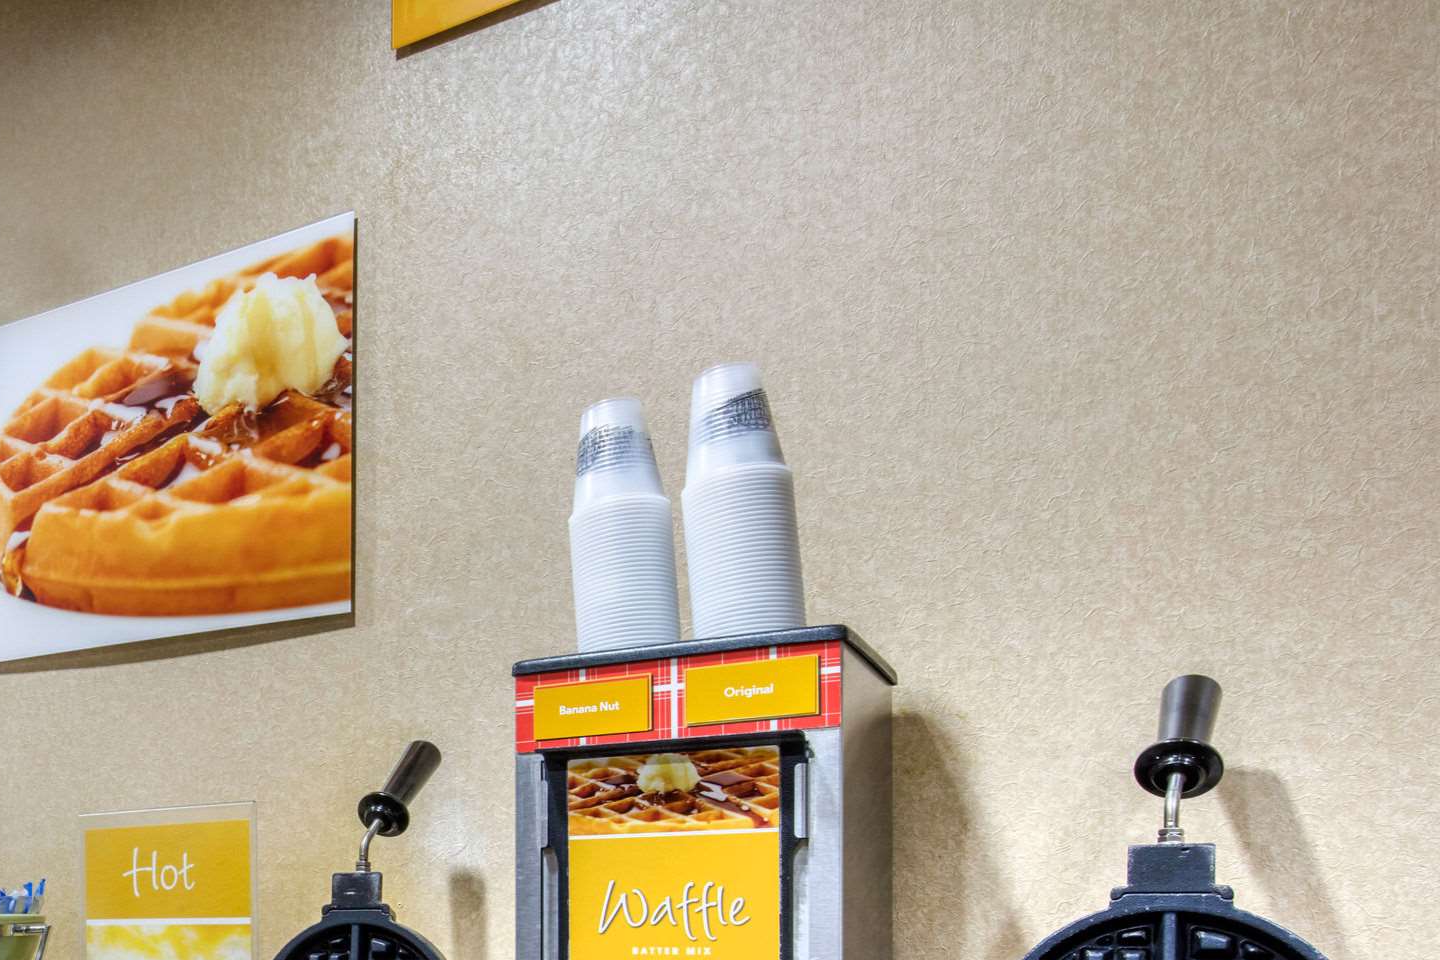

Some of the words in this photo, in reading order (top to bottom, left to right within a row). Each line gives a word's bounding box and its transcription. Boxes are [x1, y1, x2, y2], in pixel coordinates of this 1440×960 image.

[723, 684, 774, 698] Original
[559, 704, 597, 716] Banana
[600, 701, 620, 711] Nut
[122, 847, 196, 897] Hot
[598, 879, 752, 941] Waffle
[632, 946, 680, 956] BATTER
[686, 946, 712, 956] MIX
